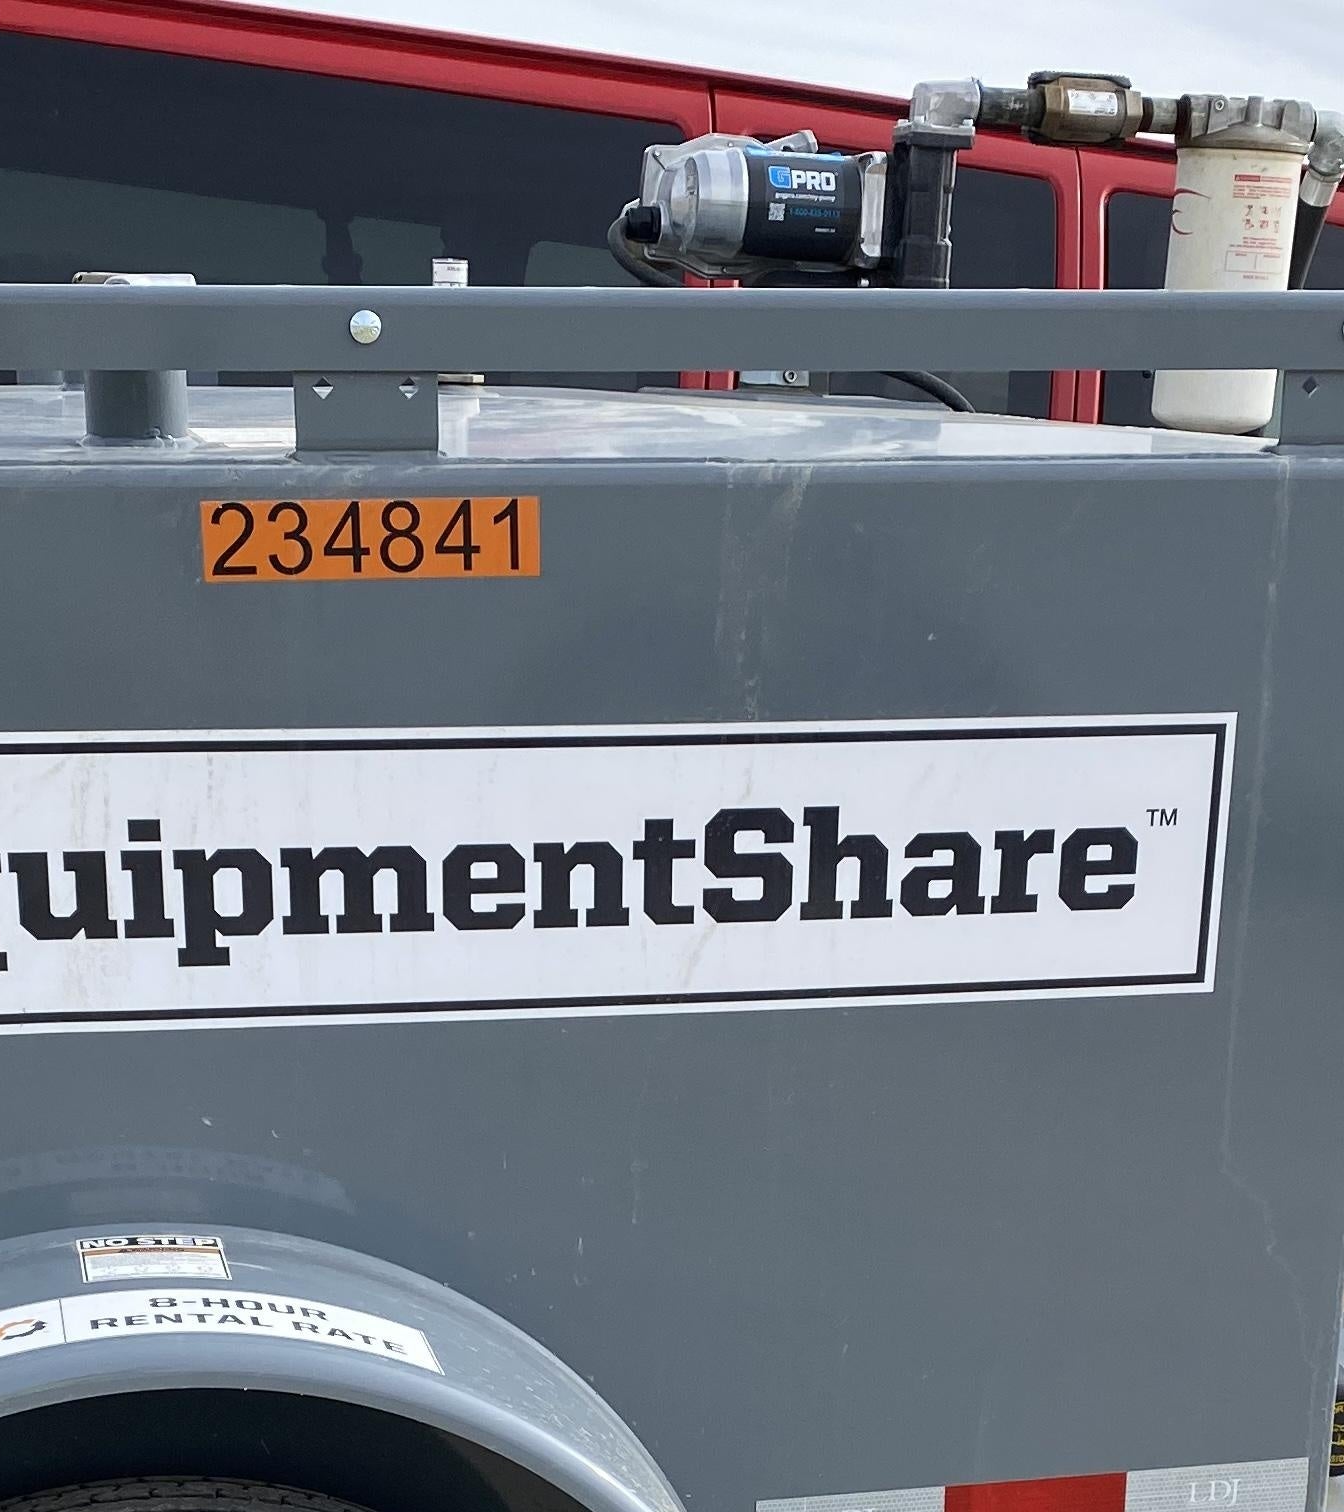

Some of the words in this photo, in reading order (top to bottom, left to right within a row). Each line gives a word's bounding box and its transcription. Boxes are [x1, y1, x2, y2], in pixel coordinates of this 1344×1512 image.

[211, 498, 528, 577] 234841
[82, 1239, 129, 1249] NO
[137, 1237, 216, 1247] STEP
[148, 1296, 328, 1320] 8-HOUR
[89, 1312, 275, 1331] RENTAL
[292, 1321, 408, 1354] RATE
[1187, 1477, 1243, 1508] LDJ
